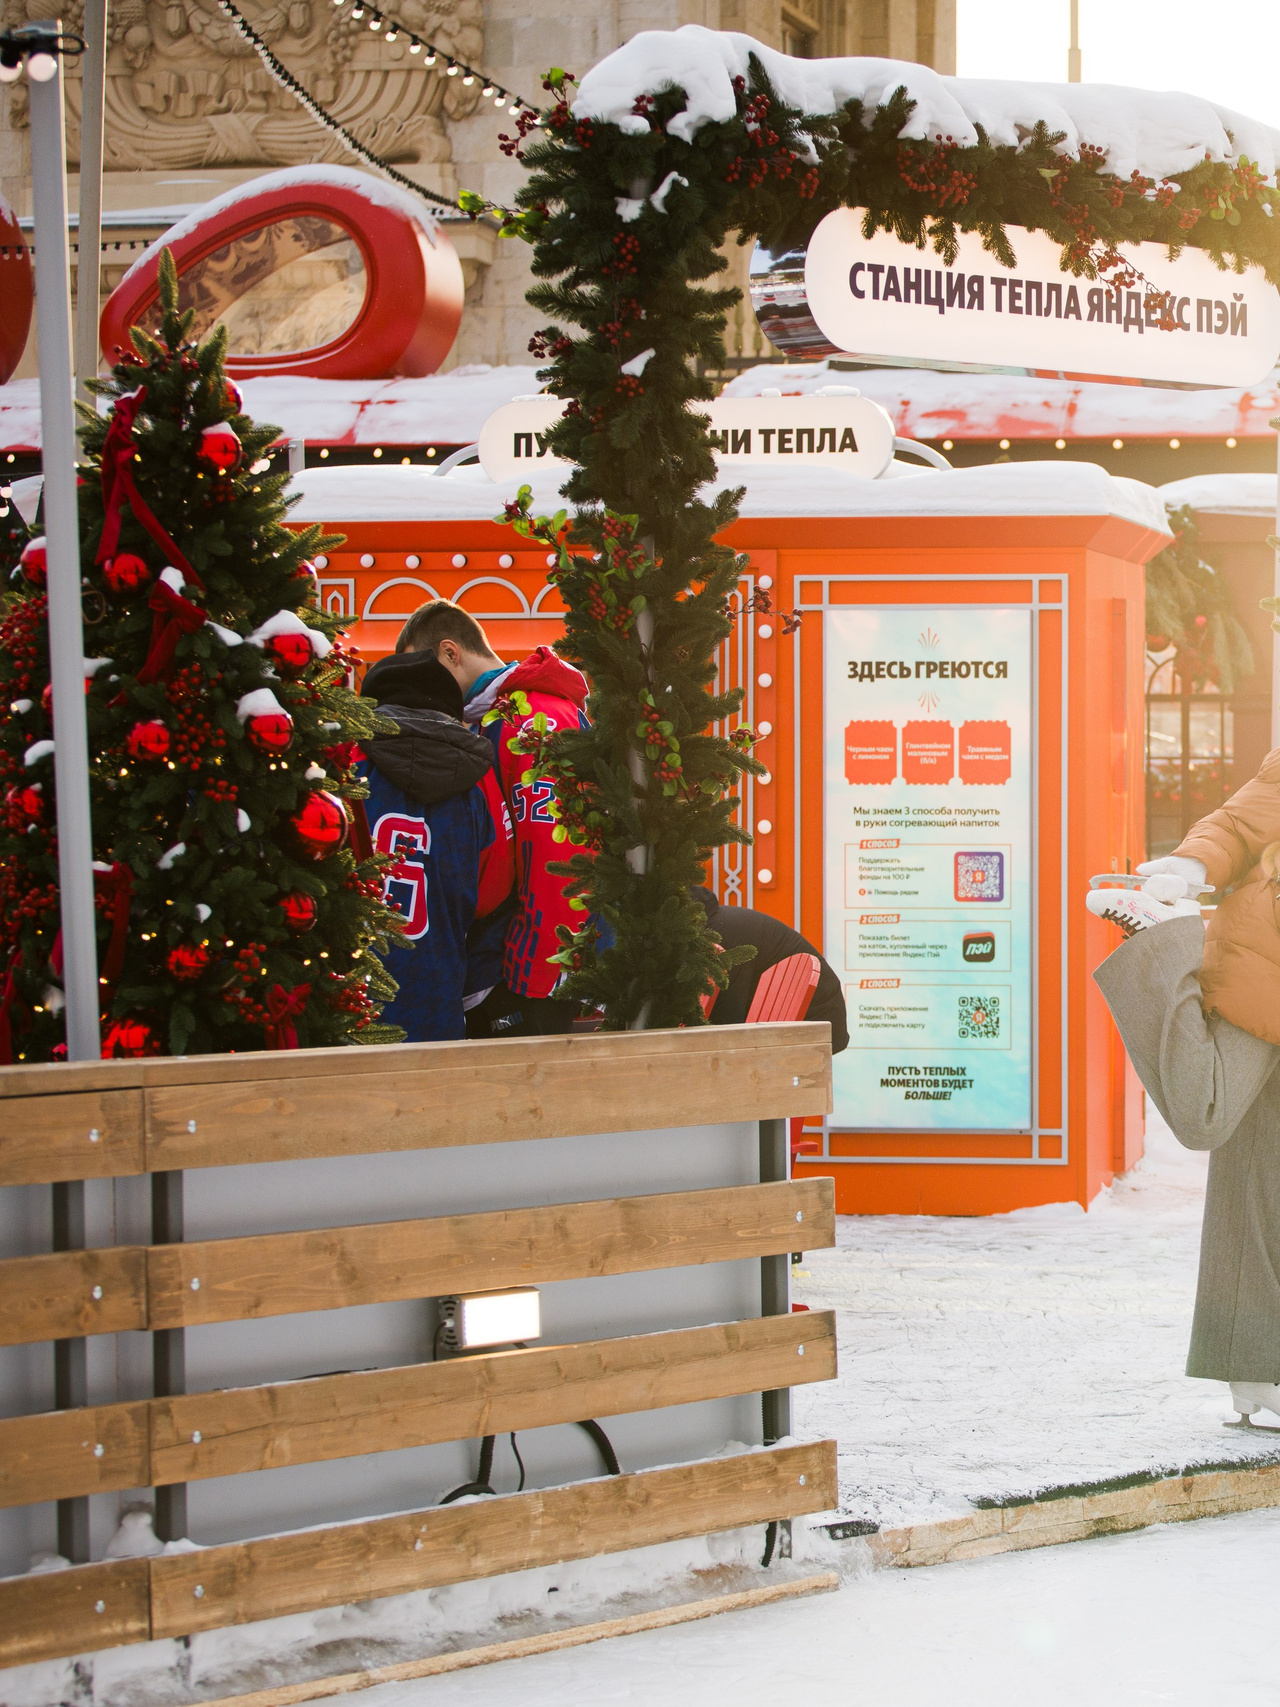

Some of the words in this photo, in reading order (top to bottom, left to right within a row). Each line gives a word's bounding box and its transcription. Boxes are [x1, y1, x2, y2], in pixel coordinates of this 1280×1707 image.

[849, 261, 985, 315] СТАНЦИЯ
[990, 276, 1083, 321] ТЕПЛА
[1086, 287, 1191, 334] ЯНДЕКС
[1196, 292, 1248, 337] ПЭЙ
[758, 427, 859, 454] ТЕПЛА
[848, 661, 911, 682] ЗДЕСЬ
[915, 661, 1008, 679] ГРЕЮТСЯ
[967, 745, 1002, 753] Травяным
[854, 807, 870, 815] Мы
[904, 807, 910, 815] 3
[912, 806, 951, 815] способа
[955, 808, 1000, 817] получить
[863, 820, 887, 829] руки
[889, 819, 958, 829] согревающий
[868, 839, 898, 848] СПОСОБ
[372, 812, 431, 940] 6
[868, 915, 898, 923] СПОСОБ
[890, 942, 926, 950] купленный
[965, 942, 992, 955] ПЭЙ
[868, 980, 898, 988] СПОСОБ
[888, 1066, 921, 1076] ПУСТЬ
[922, 1066, 967, 1076] ТЕПЛЫХ
[880, 1079, 940, 1088] МОМЕНТОВ
[941, 1079, 974, 1090] БУДЕТ
[904, 1091, 952, 1100] БОЛЬШЕ!
